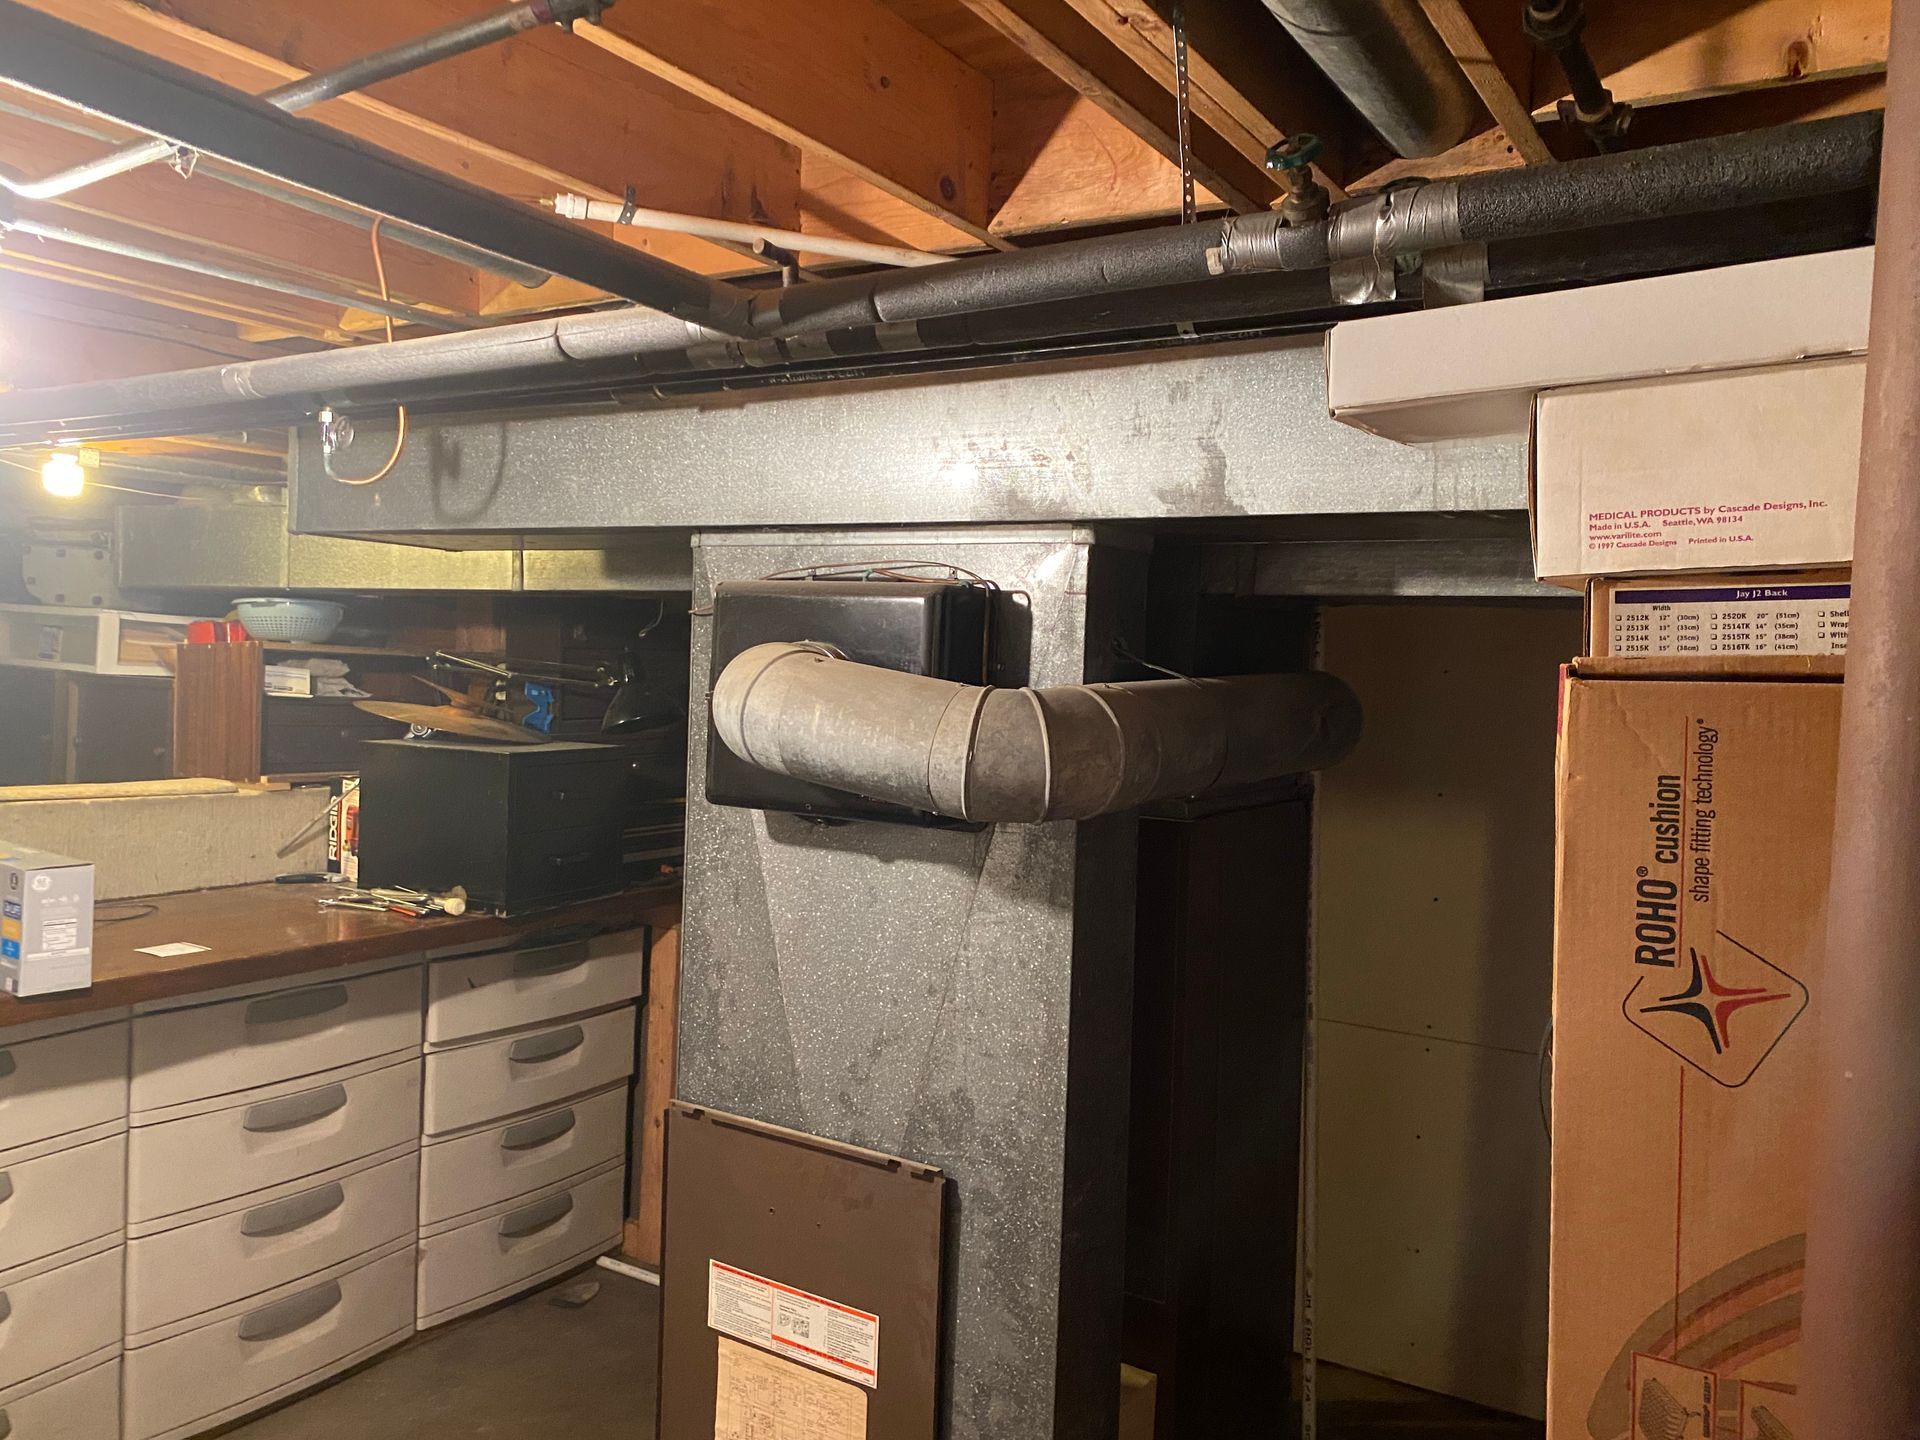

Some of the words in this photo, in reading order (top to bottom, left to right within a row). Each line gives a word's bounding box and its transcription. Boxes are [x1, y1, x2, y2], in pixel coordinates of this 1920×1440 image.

[1589, 511, 1637, 521] MEDICAL
[1640, 507, 1701, 518] PRODUCTS
[1704, 507, 1715, 516] by
[1718, 504, 1760, 513] Cascade
[1763, 501, 1807, 511] Designs,
[1809, 500, 1828, 508] Inc.
[1624, 521, 1651, 529] U.S.A.
[1663, 518, 1696, 527] Seattle,
[1717, 515, 1743, 524] 98134
[1589, 532, 1662, 541] www.varilite.com
[1736, 590, 1750, 599] Jay
[1752, 590, 1762, 598] J2
[1764, 589, 1788, 597] Back
[1648, 774, 1681, 864] cushion
[1689, 809, 1716, 853] fitting
[1689, 856, 1715, 902] shape
